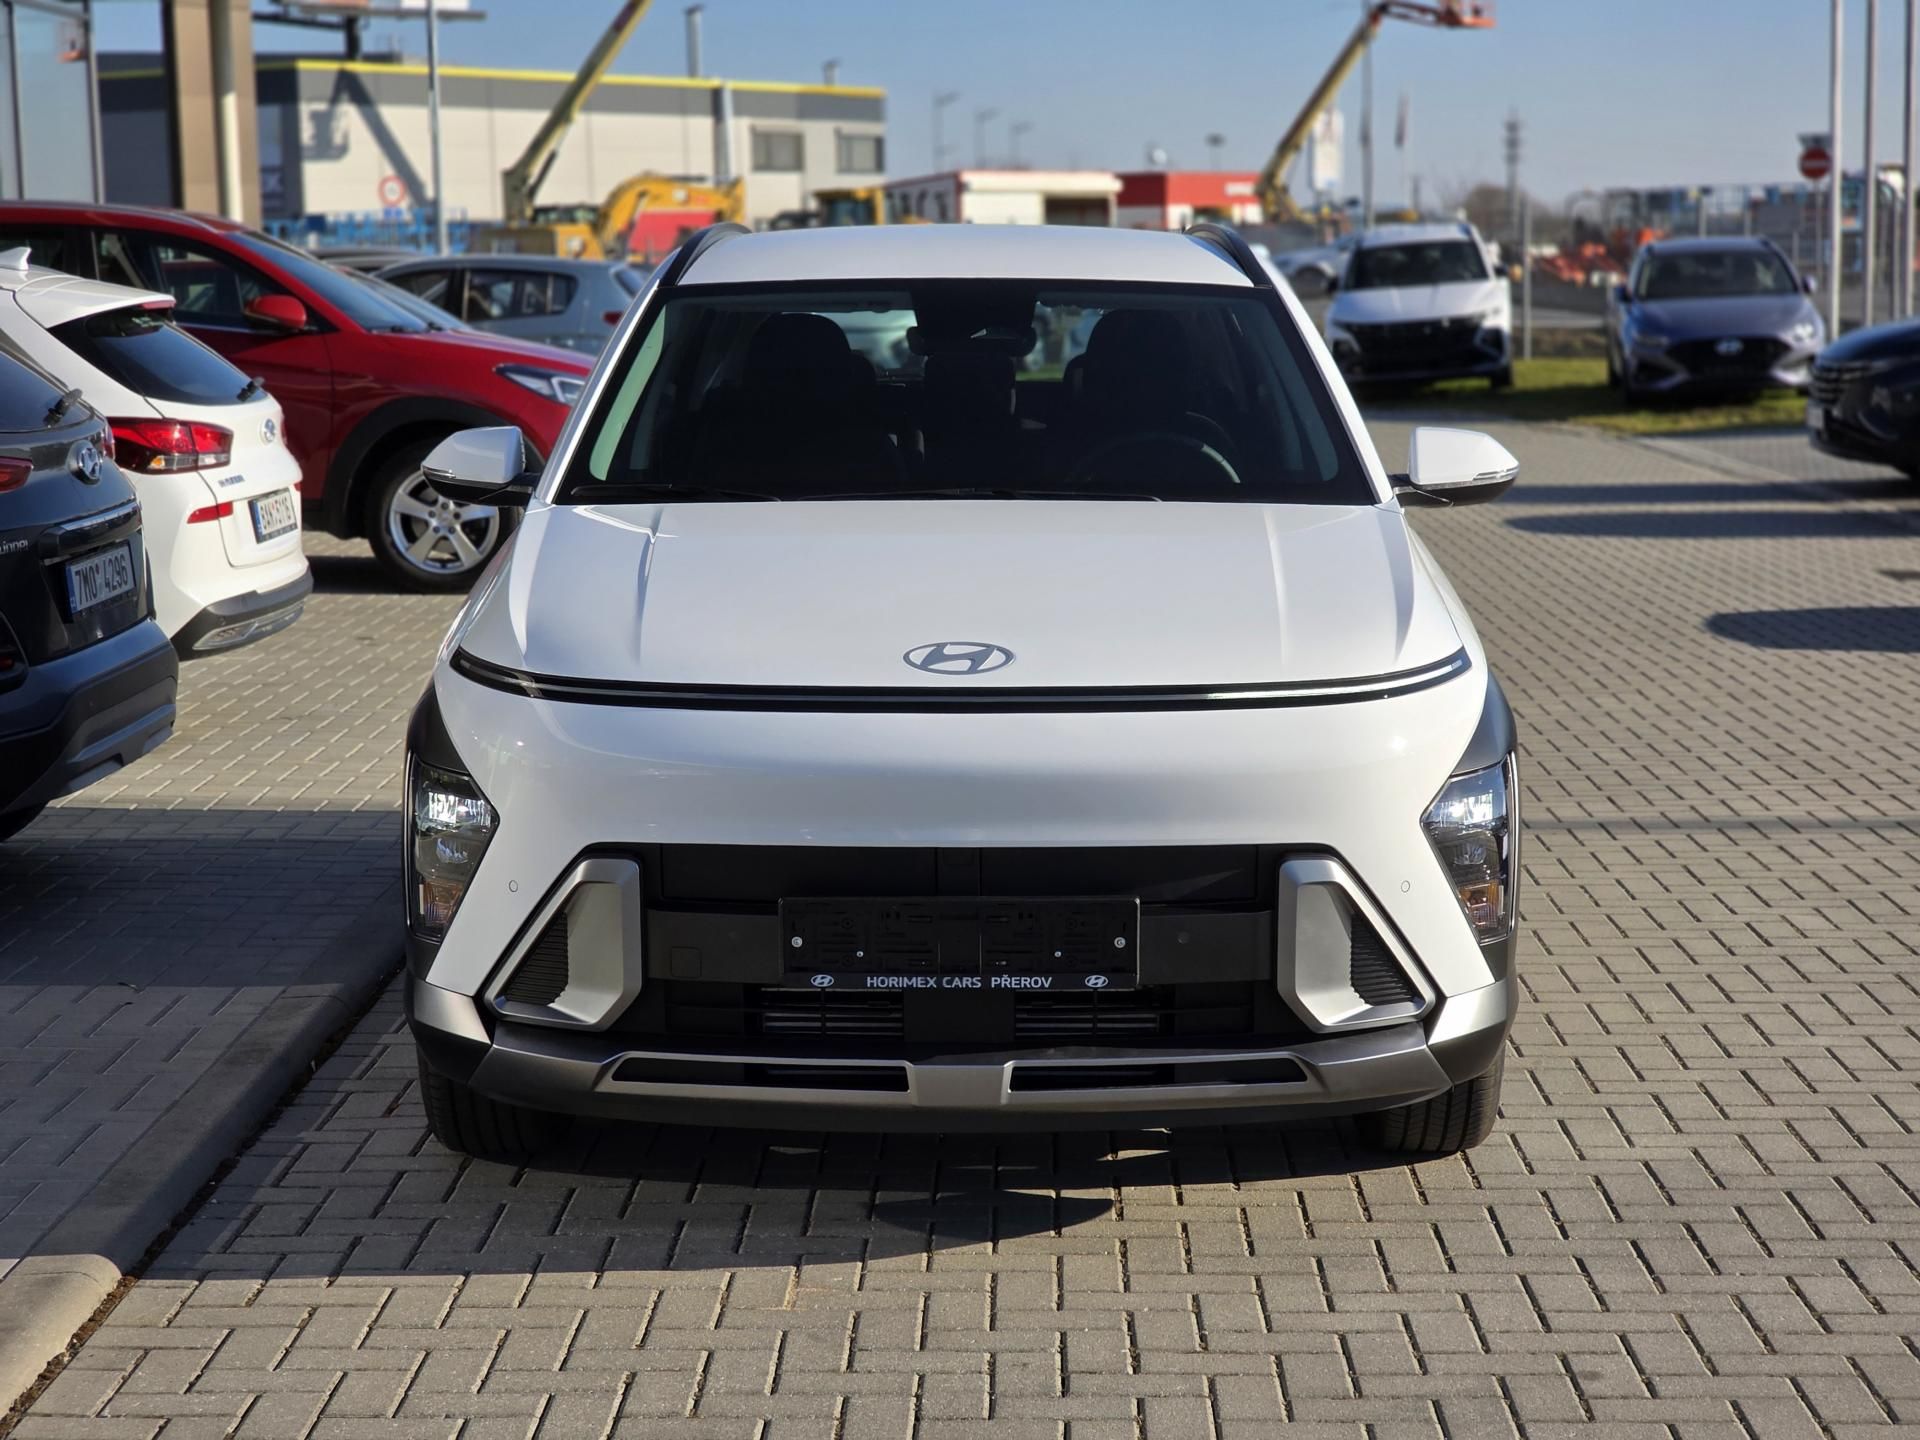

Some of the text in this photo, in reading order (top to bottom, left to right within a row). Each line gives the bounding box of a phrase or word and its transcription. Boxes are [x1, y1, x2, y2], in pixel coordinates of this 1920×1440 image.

[103, 553, 128, 593] 4296
[866, 974, 1053, 988] HORIMEX CARS PŘEROV
